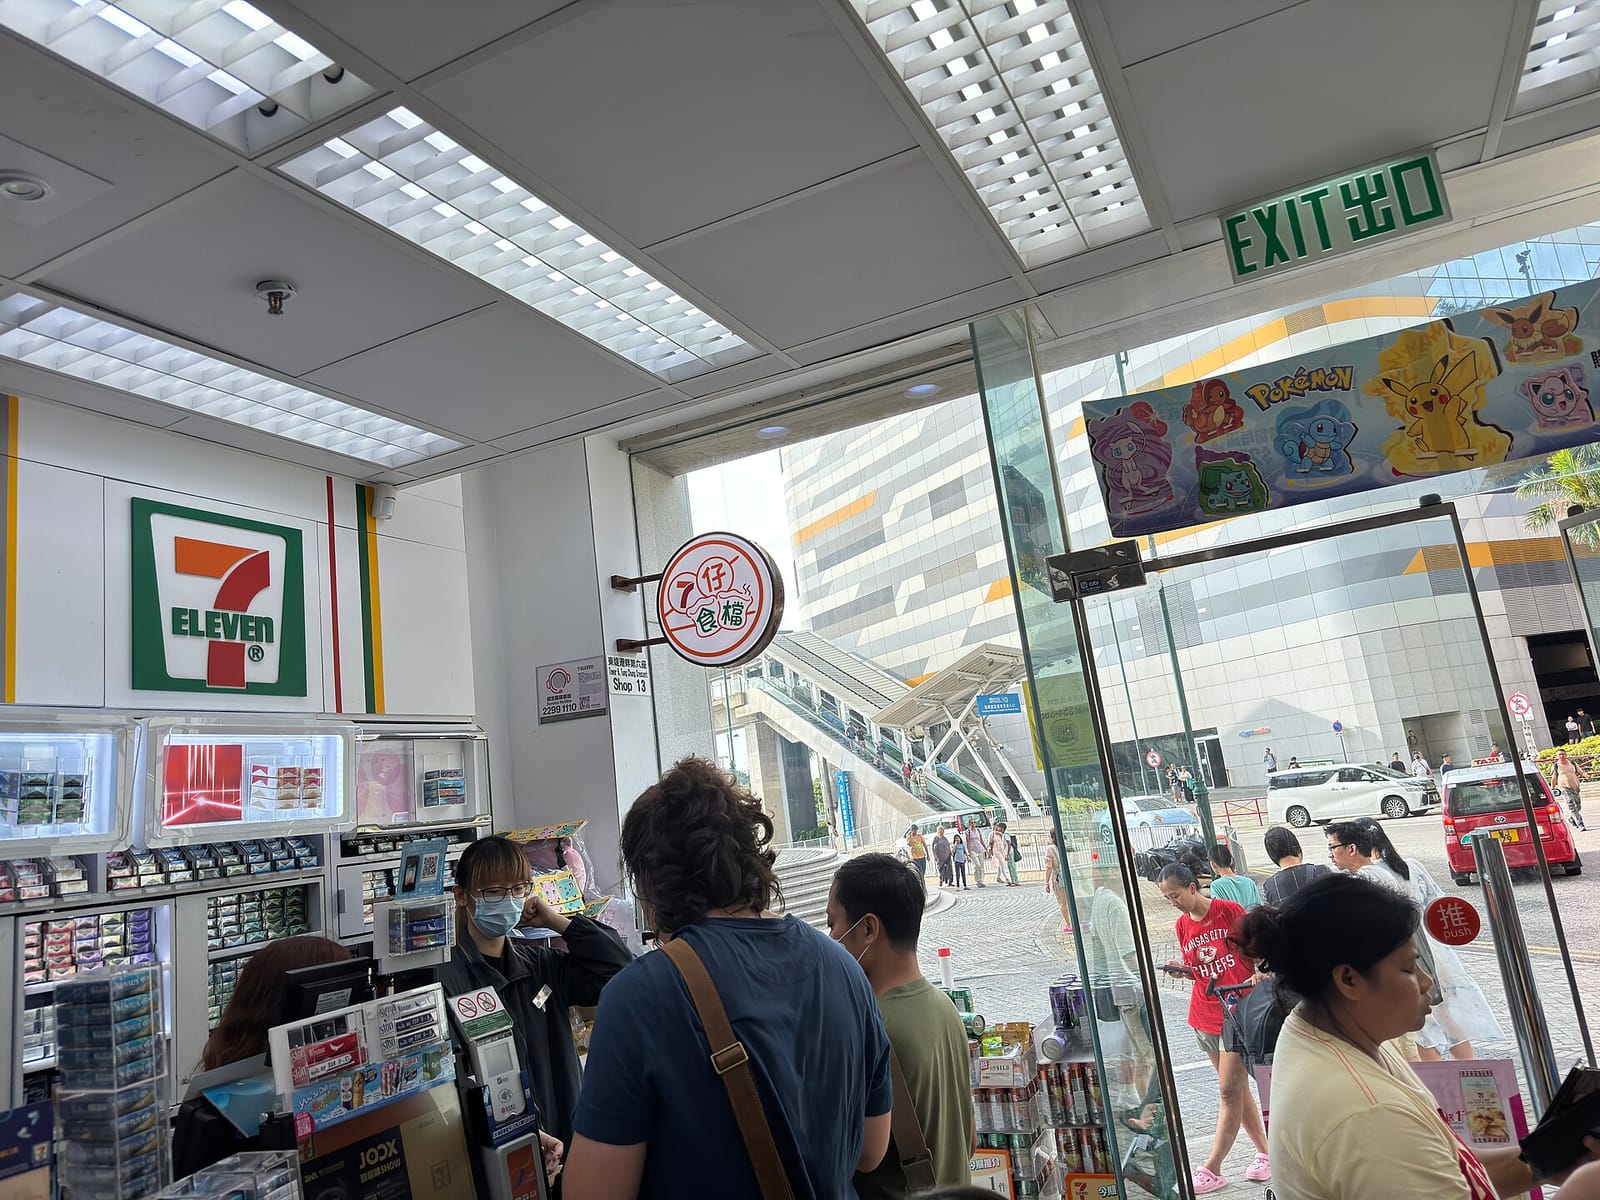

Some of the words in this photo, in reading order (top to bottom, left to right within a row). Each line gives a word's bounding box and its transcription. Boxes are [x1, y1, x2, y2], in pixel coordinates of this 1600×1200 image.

[1225, 194, 1331, 276] EXIT
[1338, 155, 1445, 241] 出口
[174, 536, 270, 688] 7
[171, 607, 274, 644] ELEVEN
[613, 677, 633, 693] Shop
[637, 679, 646, 692] 13
[542, 706, 561, 715] 2299
[562, 703, 577, 713] 1110
[1473, 757, 1500, 765] TAXI
[1438, 902, 1466, 930] 推
[1183, 933, 1210, 954] KANSAS
[1209, 928, 1229, 941] CITY
[1443, 925, 1472, 939] push
